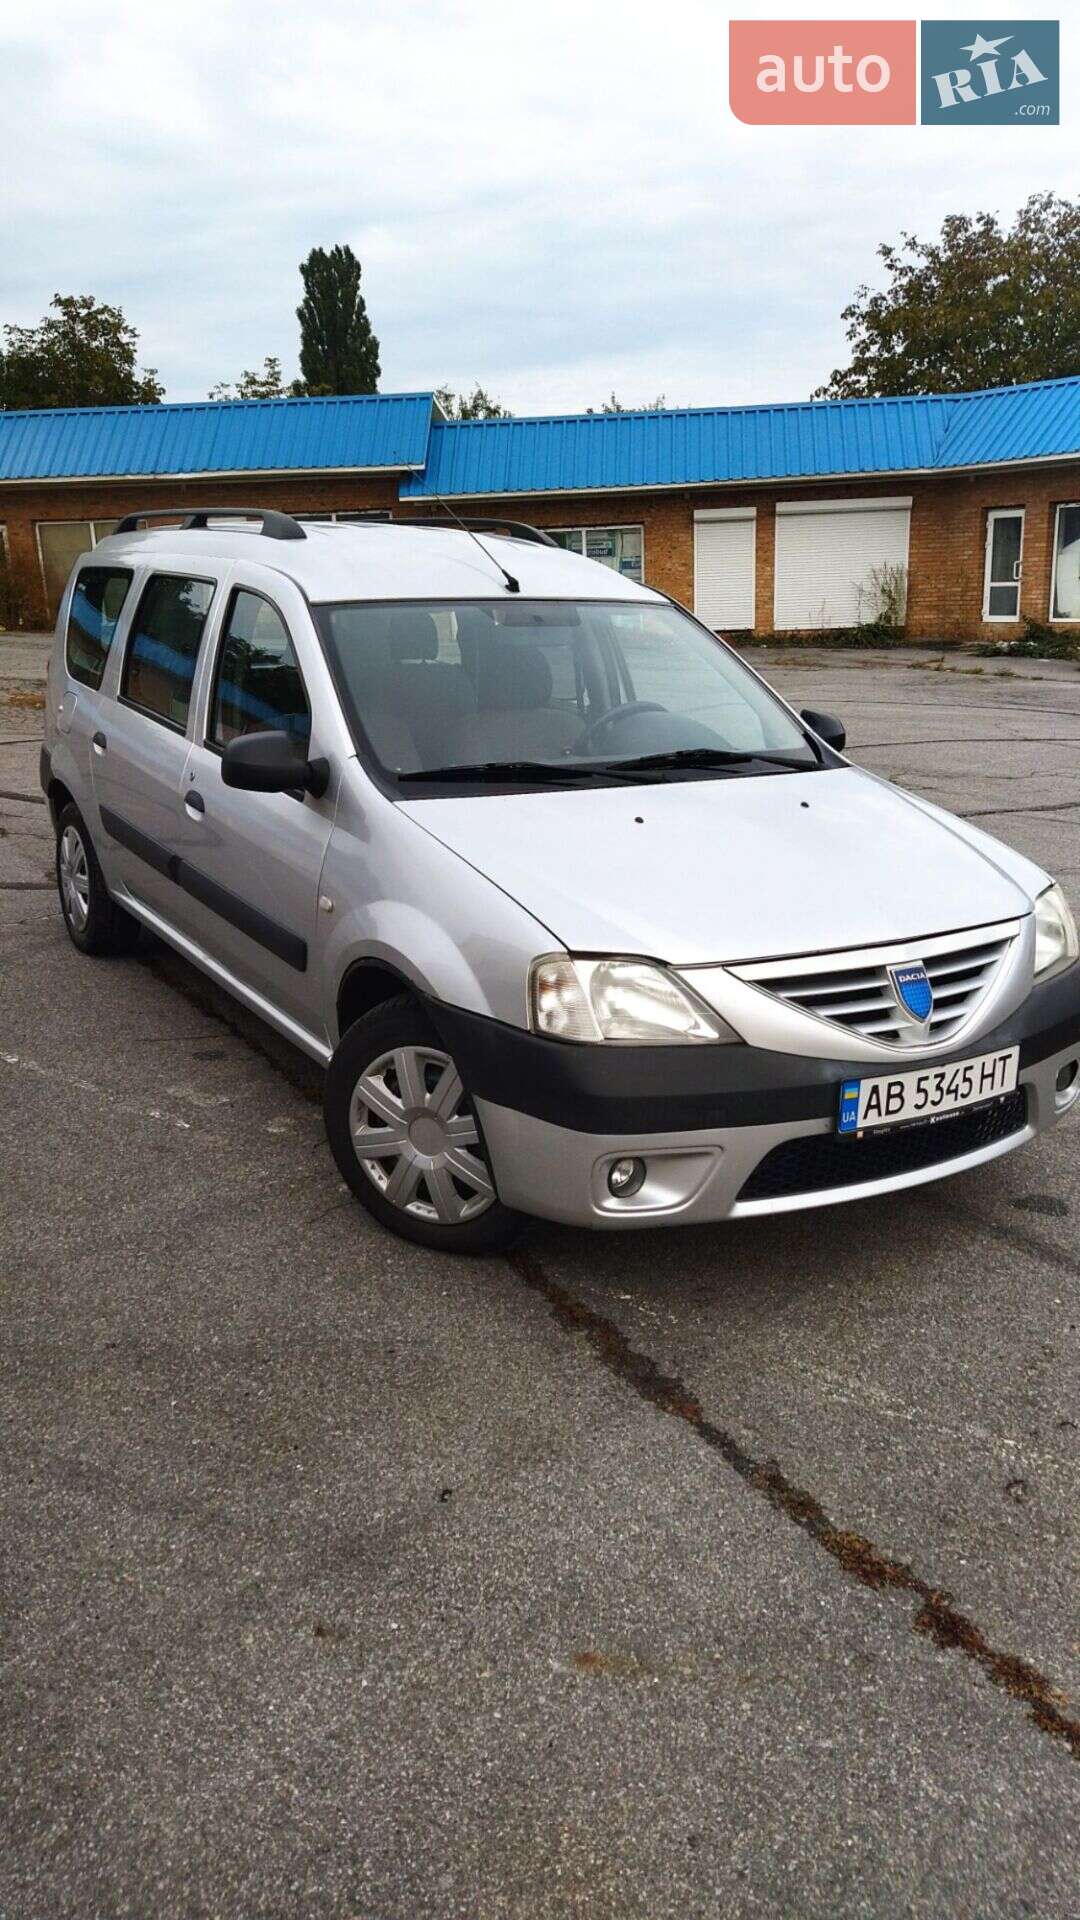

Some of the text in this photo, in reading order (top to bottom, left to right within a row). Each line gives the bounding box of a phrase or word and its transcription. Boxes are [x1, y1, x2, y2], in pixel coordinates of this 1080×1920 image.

[898, 972, 927, 983] DACIA
[863, 1053, 1012, 1120] AB 5345 HT
[842, 1111, 857, 1123] UA
